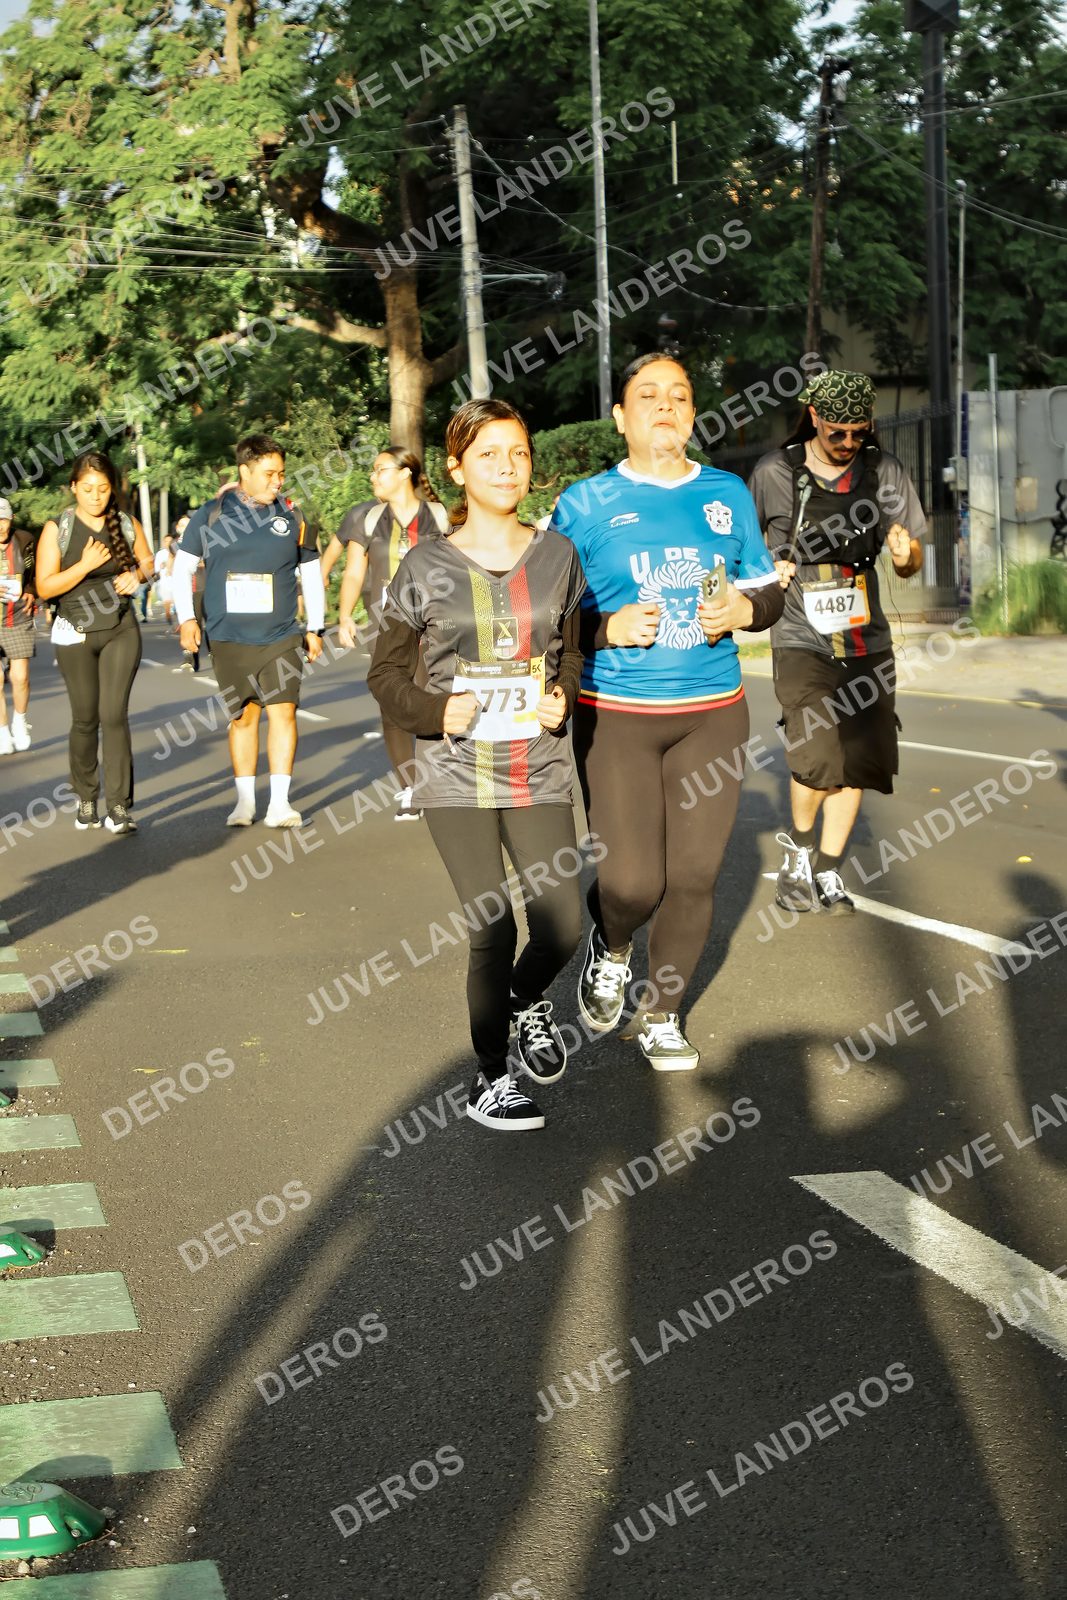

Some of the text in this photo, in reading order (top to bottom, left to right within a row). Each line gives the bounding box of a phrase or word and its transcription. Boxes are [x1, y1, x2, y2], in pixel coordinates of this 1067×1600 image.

[629, 551, 651, 584] U
[663, 547, 700, 563] DE
[814, 594, 855, 614] 4487
